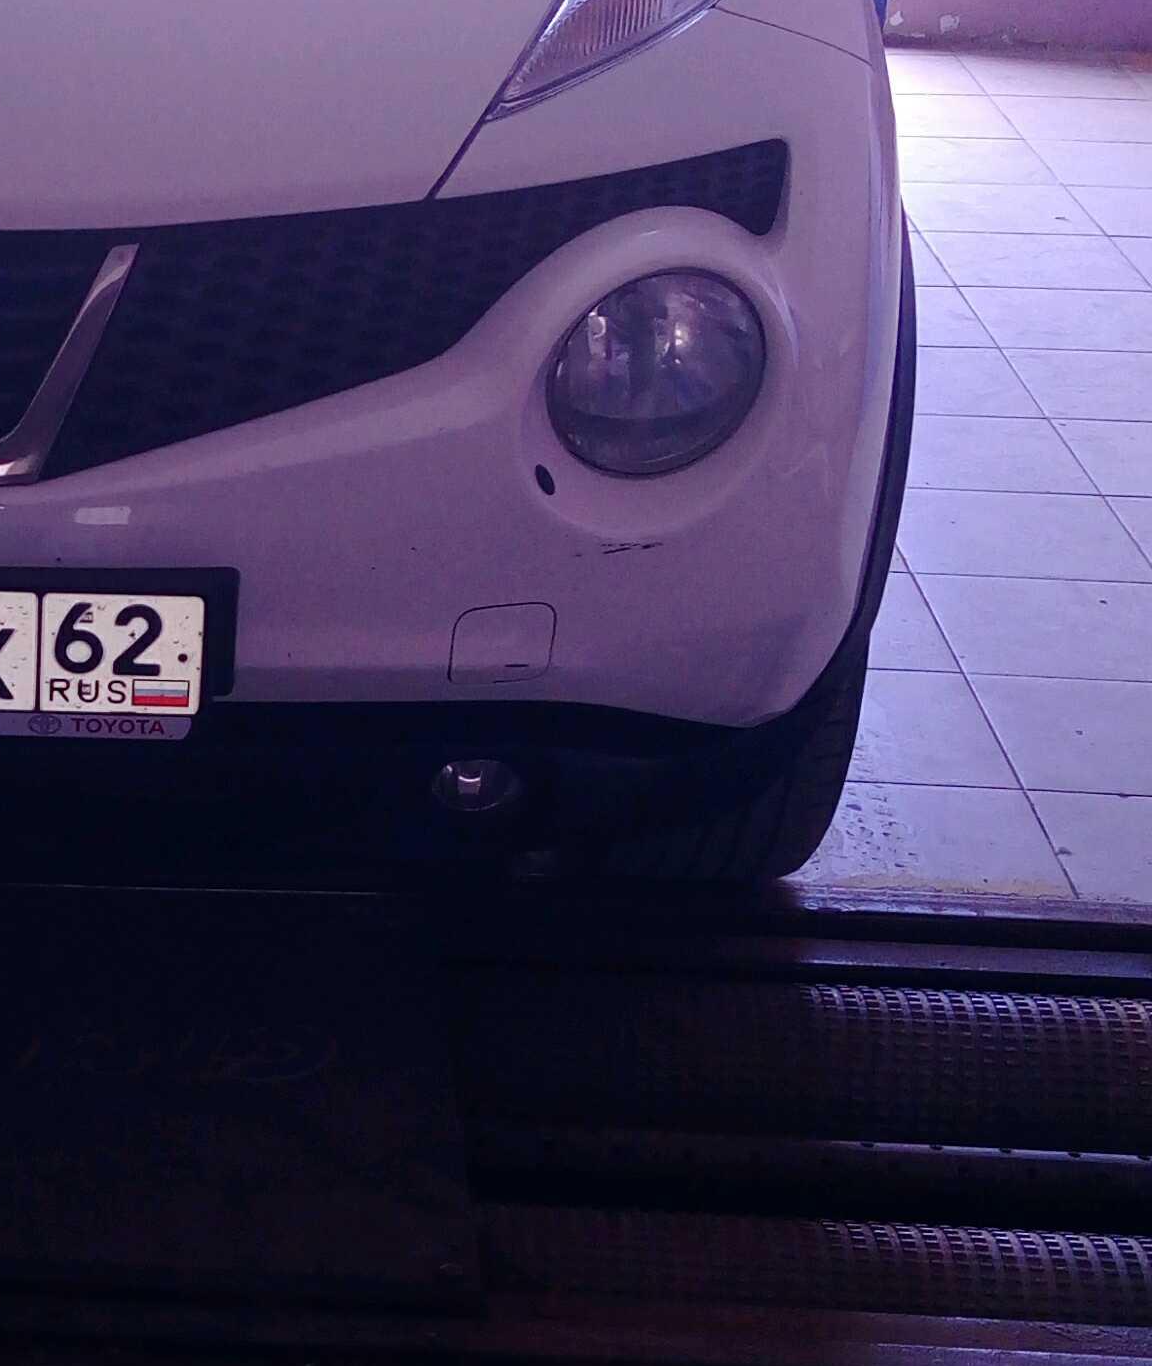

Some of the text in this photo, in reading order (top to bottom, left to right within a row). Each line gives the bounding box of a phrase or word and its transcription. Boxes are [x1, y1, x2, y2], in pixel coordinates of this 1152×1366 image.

[53, 602, 164, 677] 62
[48, 677, 127, 705] RUS
[71, 716, 166, 736] TOYOTA
